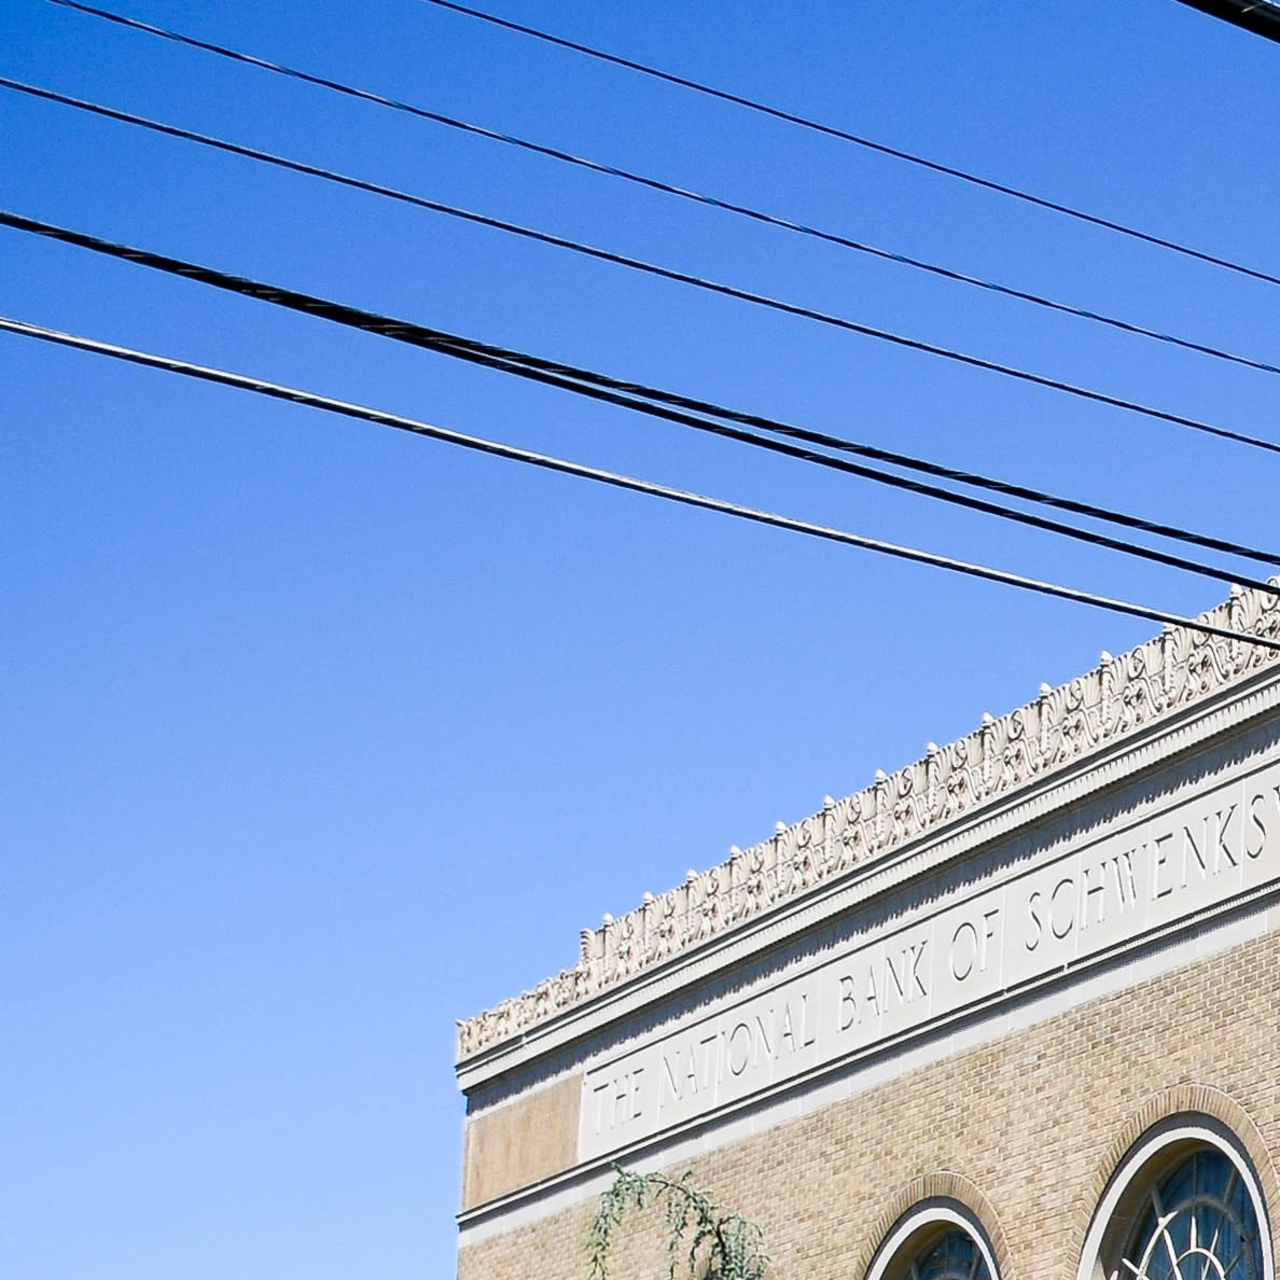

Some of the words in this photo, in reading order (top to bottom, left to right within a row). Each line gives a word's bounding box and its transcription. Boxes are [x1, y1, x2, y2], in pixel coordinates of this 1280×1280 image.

[593, 1068, 644, 1134] THE
[658, 994, 815, 1108] NATIONAL
[837, 939, 928, 1034] BANK
[950, 908, 999, 982] OF
